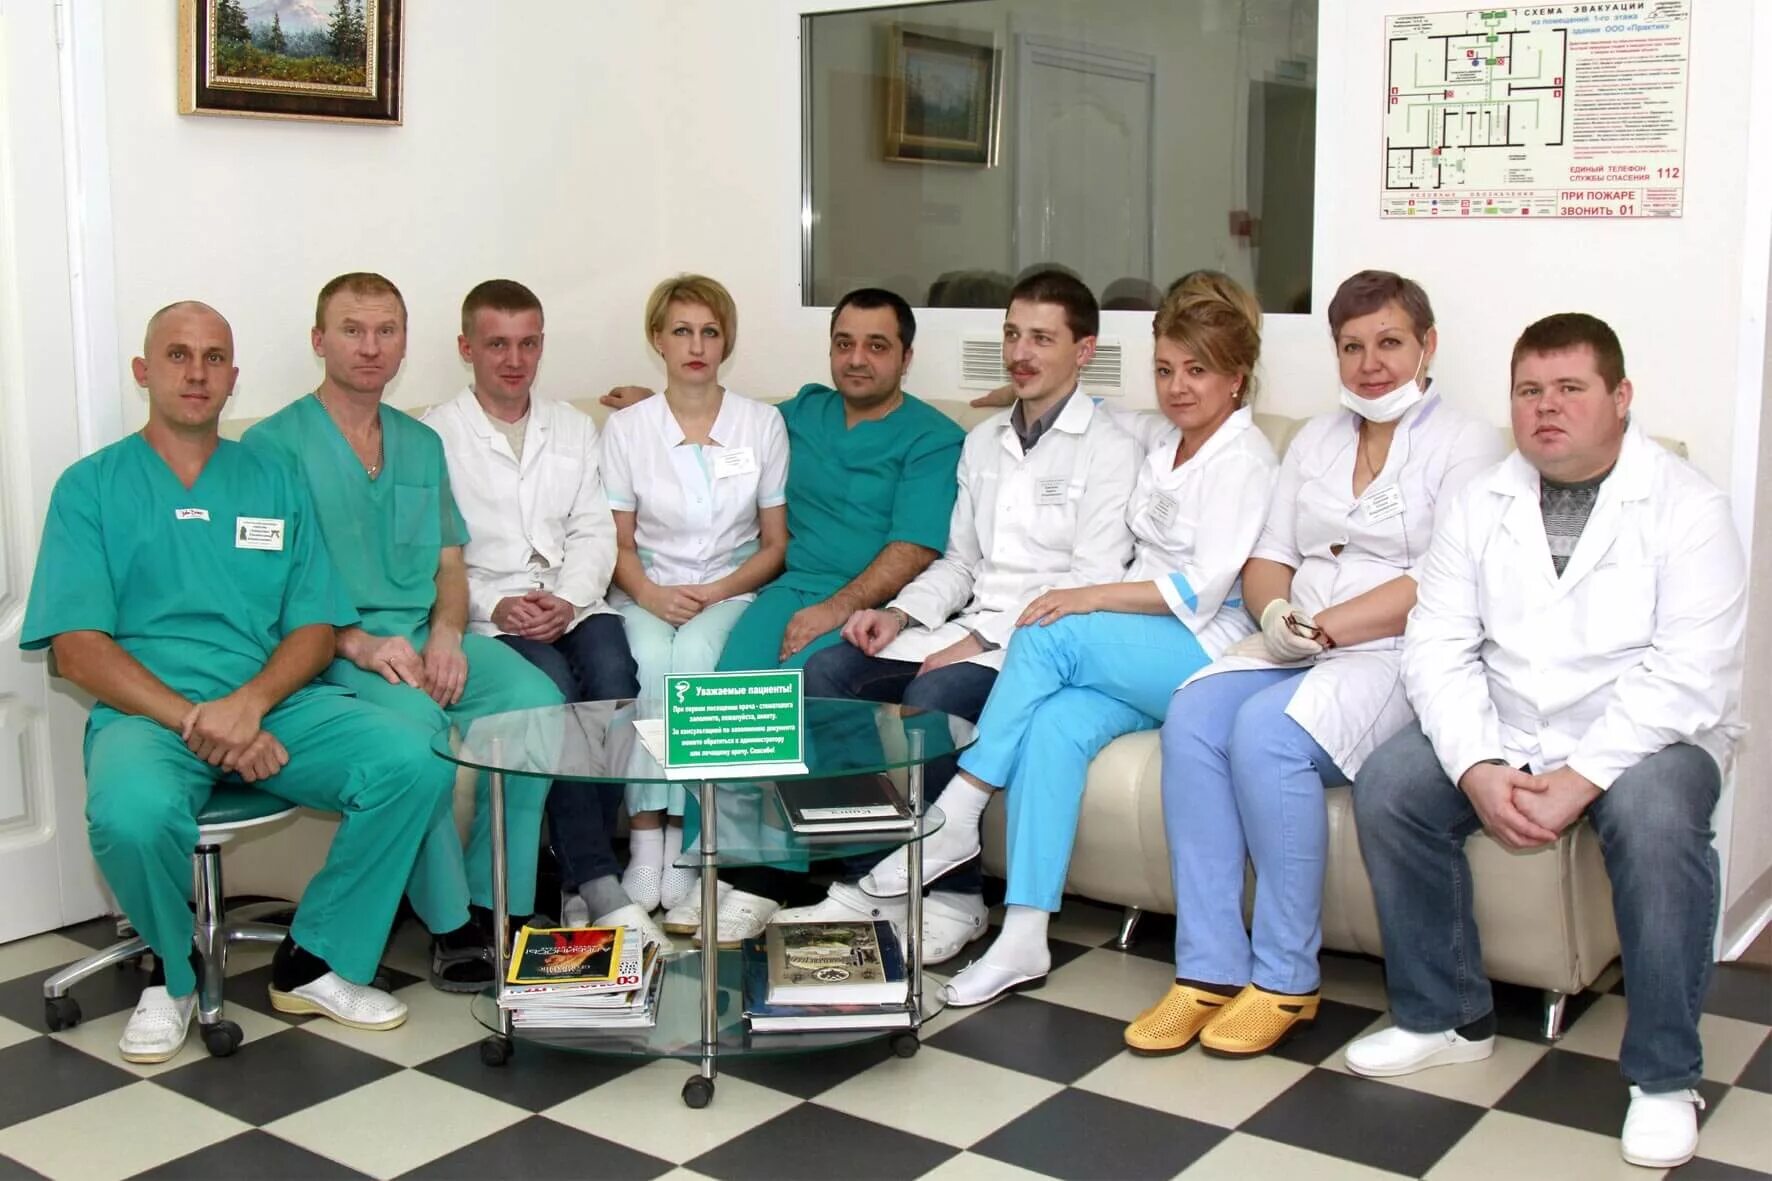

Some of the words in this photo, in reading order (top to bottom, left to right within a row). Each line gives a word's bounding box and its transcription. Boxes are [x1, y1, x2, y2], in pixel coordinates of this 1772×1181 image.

[1524, 8, 1563, 16] СХЕМА
[1573, 3, 1645, 13] ЭВАКУАЦИИ
[1542, 16, 1589, 25] помещений
[1614, 13, 1638, 21] этажа
[1572, 27, 1601, 35] здания
[1605, 24, 1625, 33] ООО
[1627, 23, 1670, 33] «Практик»
[1569, 165, 1604, 173] ЕДИНЫЙ
[1657, 167, 1680, 179] 112
[1606, 174, 1650, 182] СПАСЕНИЯ
[1561, 191, 1584, 201] ПРИ
[1586, 191, 1636, 200] ПОЖАРЕ
[1560, 206, 1614, 216] ЗВОНИТЬ
[1619, 205, 1634, 215] 01
[696, 686, 746, 697] Уважаемые
[748, 684, 793, 696] пациенты!
[672, 705, 684, 714] При
